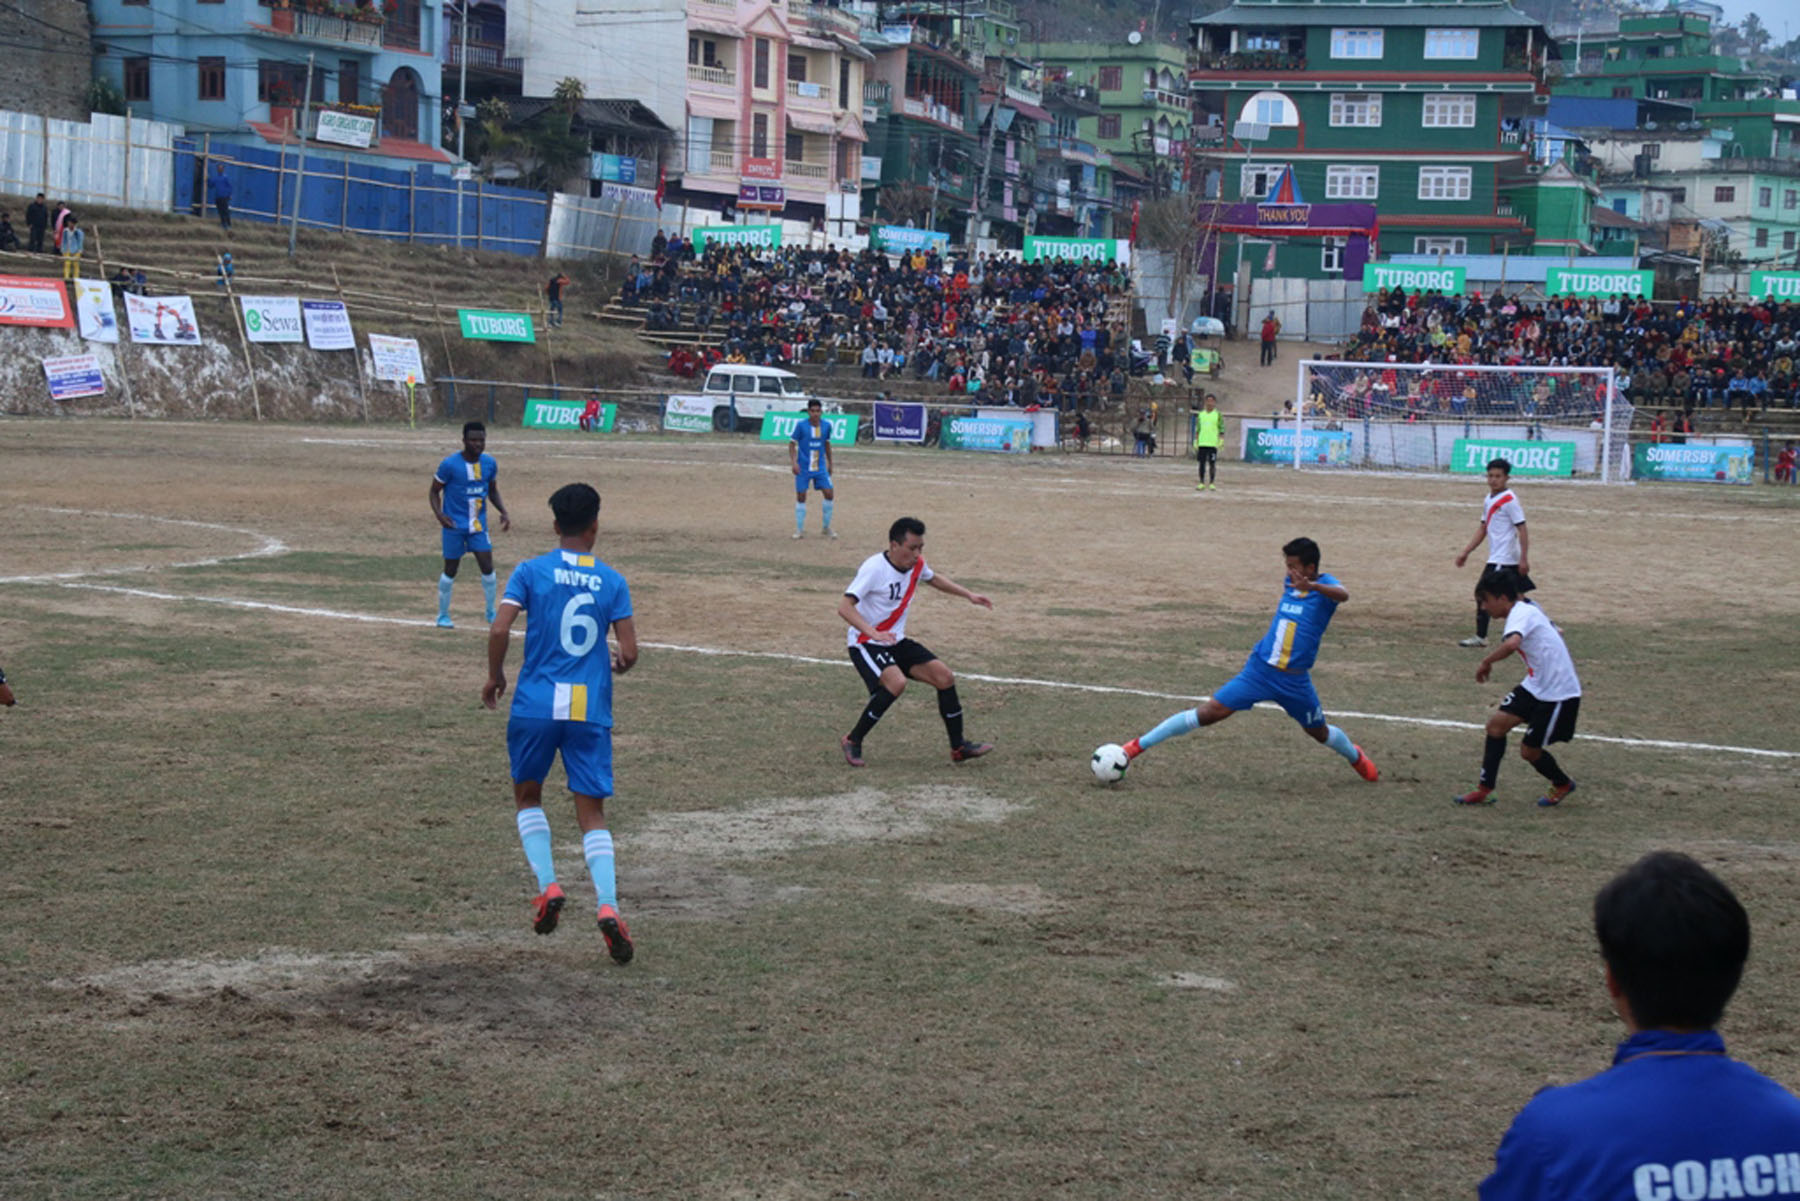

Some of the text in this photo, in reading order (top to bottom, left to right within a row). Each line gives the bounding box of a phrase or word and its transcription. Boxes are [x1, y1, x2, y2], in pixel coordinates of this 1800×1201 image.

[1257, 207, 1310, 222] THANK YOU
[702, 228, 772, 247] TUBORG
[1032, 240, 1106, 262] TUBORG
[1374, 267, 1454, 290] TUBORG
[1557, 271, 1642, 294] TUBORG
[467, 313, 527, 338] TUBORG
[535, 403, 606, 428] TUBOG
[772, 415, 847, 440] TUG
[950, 420, 1005, 436] SOMERSBY
[1464, 443, 1560, 471] TUBORG
[1646, 446, 1717, 465] SOMERSBY
[553, 567, 602, 591] MVFC
[888, 581, 902, 601] 12
[560, 592, 599, 657] 6
[1633, 1152, 1800, 1201] COACH
